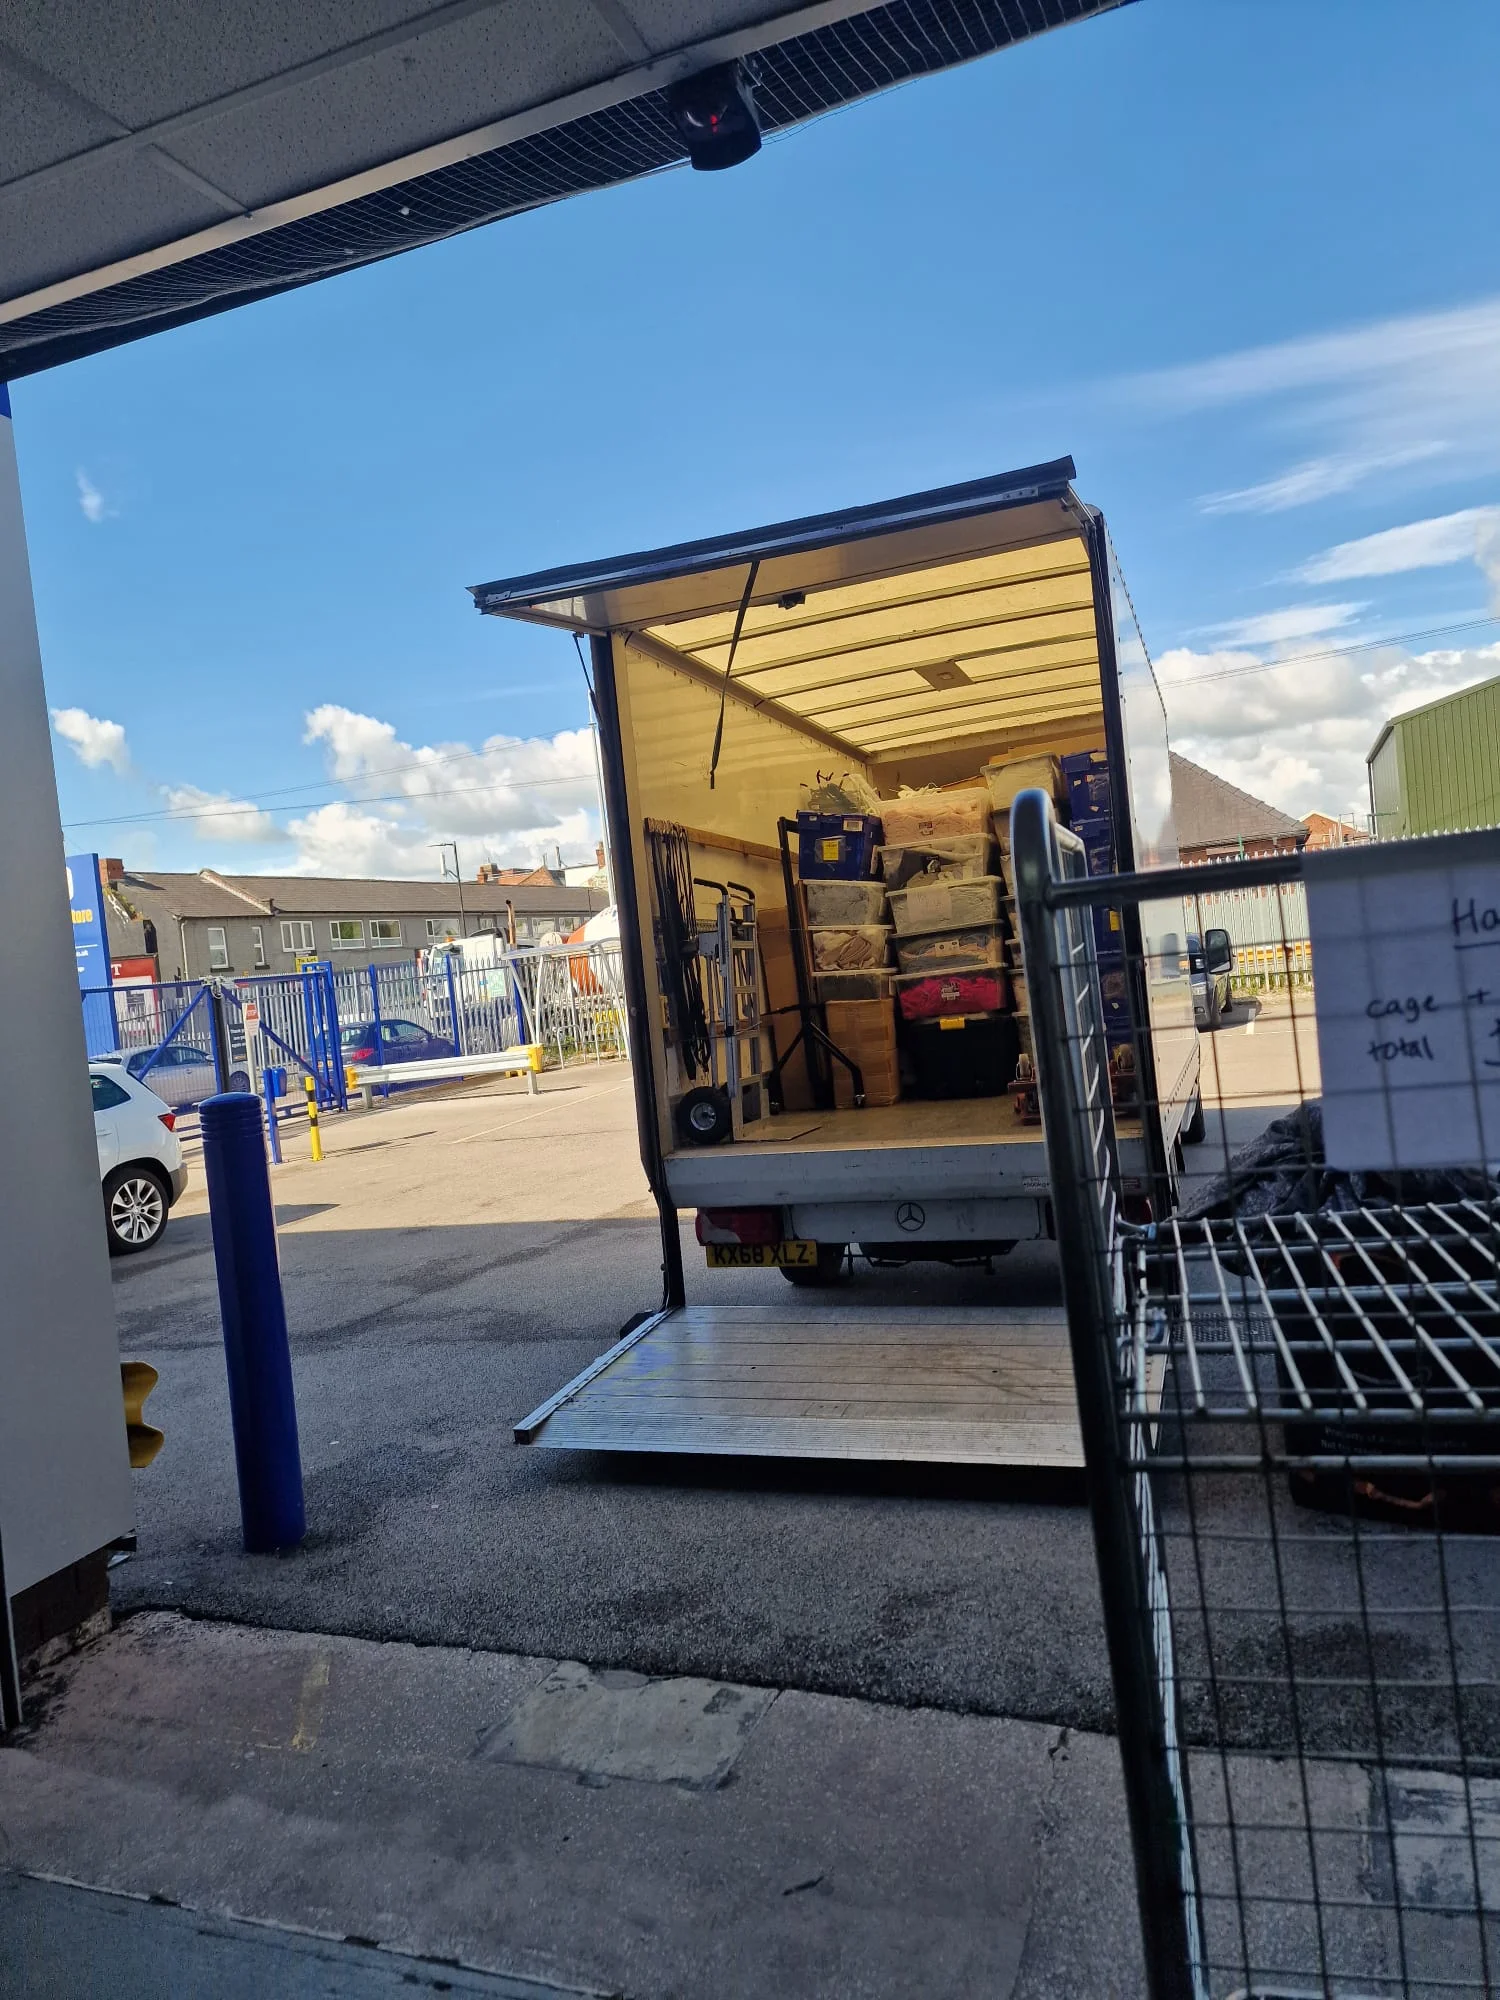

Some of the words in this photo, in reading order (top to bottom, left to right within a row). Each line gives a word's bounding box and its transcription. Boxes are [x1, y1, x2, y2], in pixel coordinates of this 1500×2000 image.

[1366, 993, 1440, 1023] cage
[1366, 1034, 1434, 1061] total
[770, 1243, 810, 1265] XLZ
